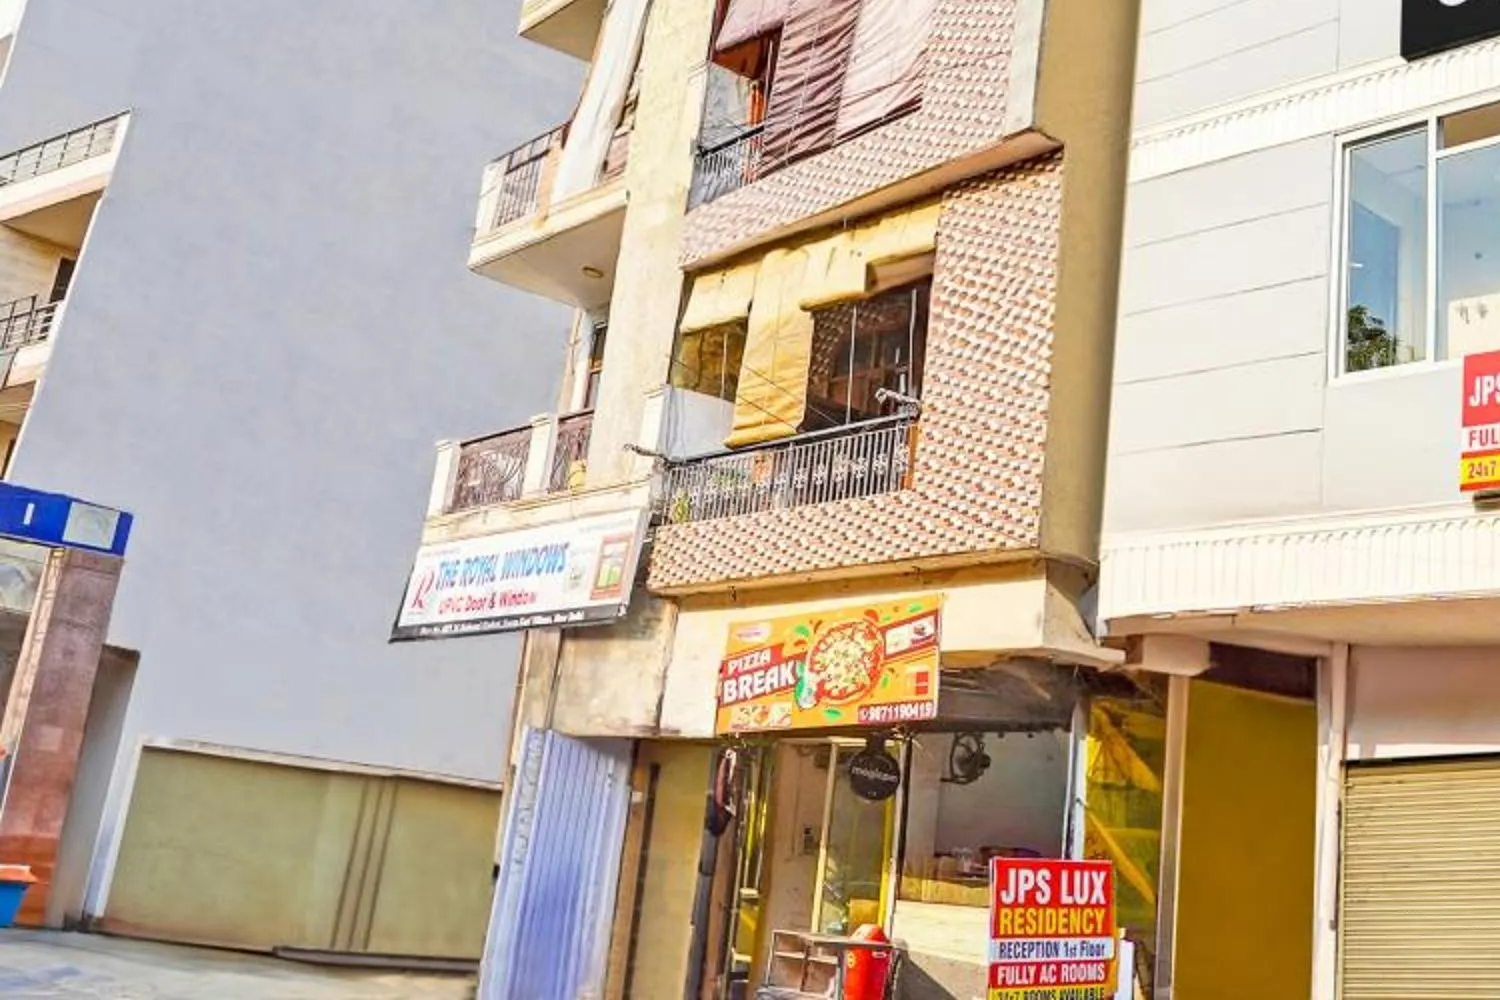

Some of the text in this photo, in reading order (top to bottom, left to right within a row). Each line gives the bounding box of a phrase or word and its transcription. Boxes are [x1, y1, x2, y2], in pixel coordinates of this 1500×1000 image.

[728, 648, 771, 677] PIZZA
[724, 660, 796, 704] BREAK
[1000, 867, 1108, 905] JPS LUX
[999, 907, 1106, 936] RESIDENCY
[1000, 941, 1060, 959] RECEPTION
[1080, 940, 1105, 957] Floor
[997, 962, 1105, 985] FULLY AC ROOMS
